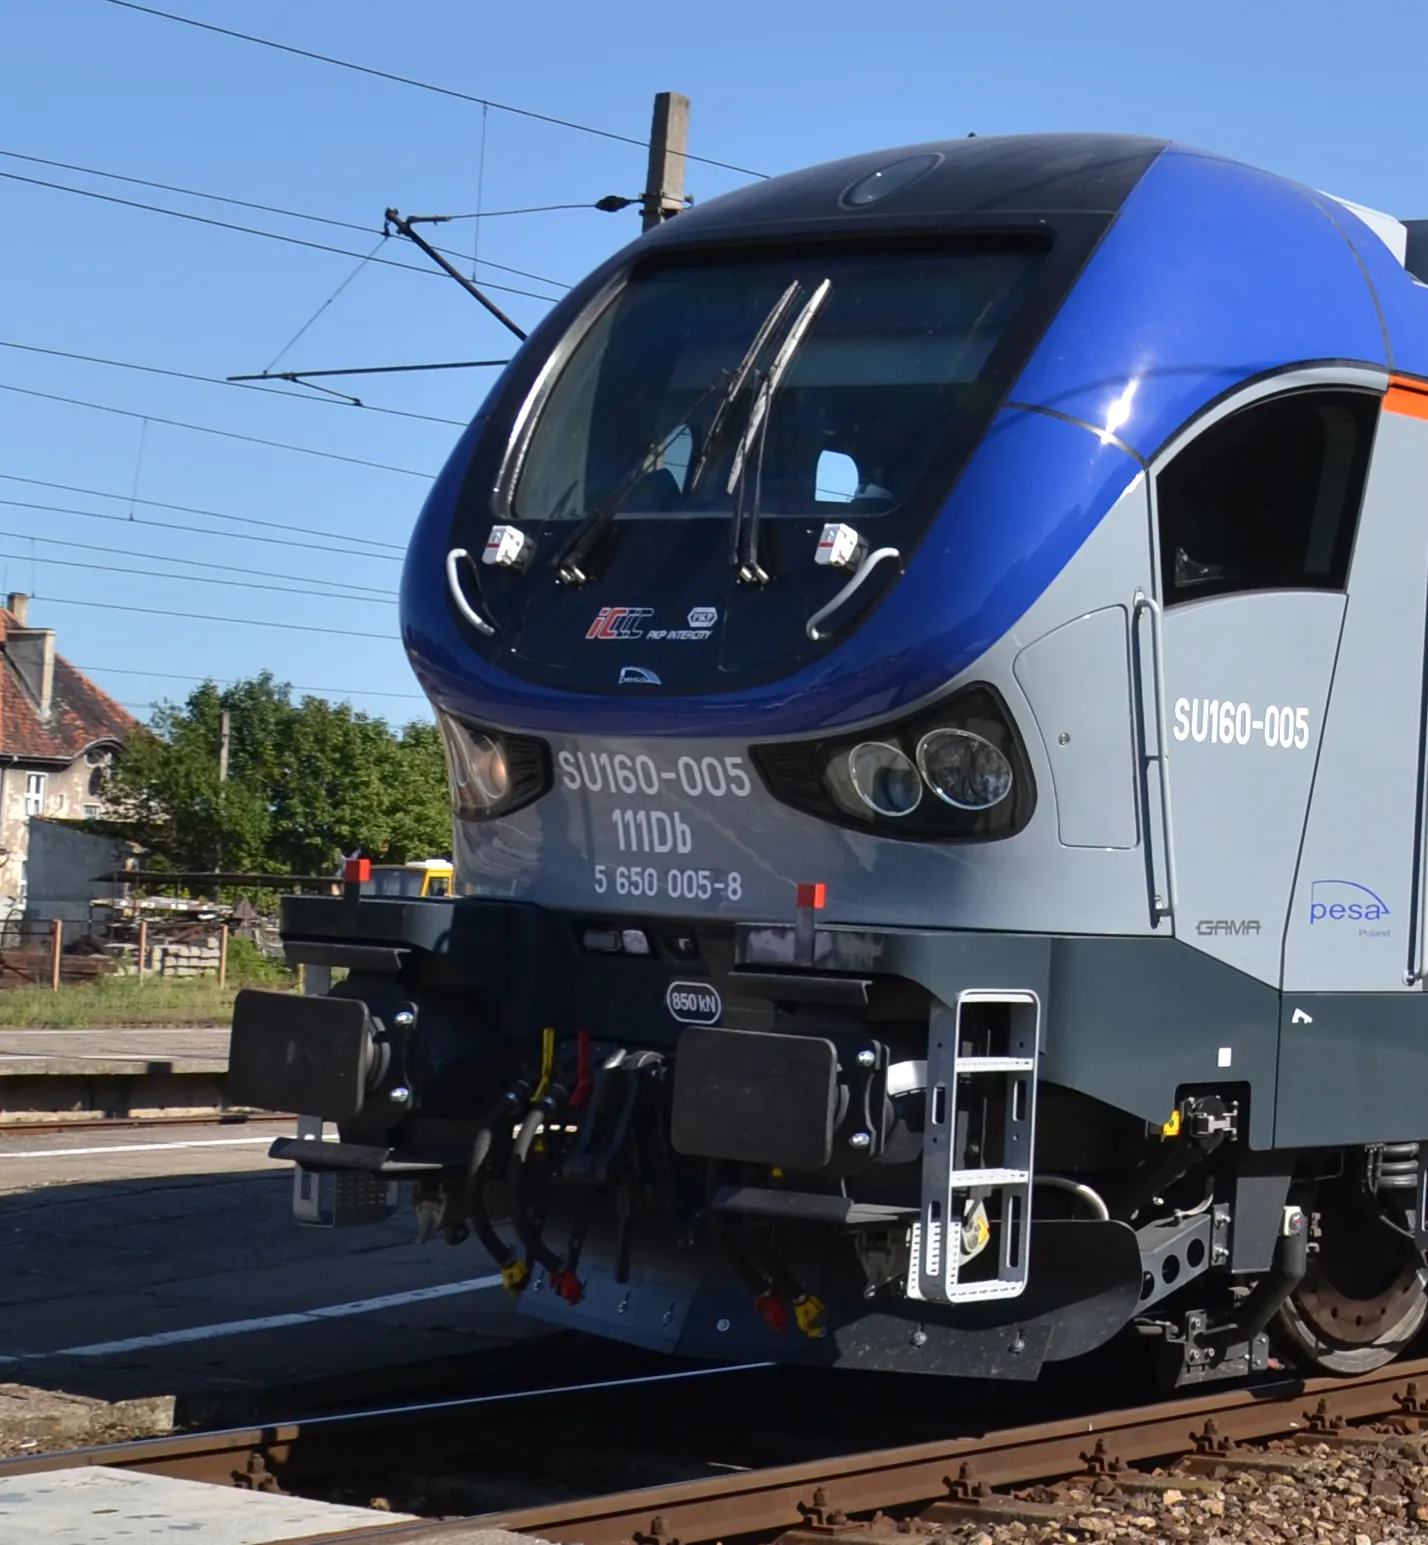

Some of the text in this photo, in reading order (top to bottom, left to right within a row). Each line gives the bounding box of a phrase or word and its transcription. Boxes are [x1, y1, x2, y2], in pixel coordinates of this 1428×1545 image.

[646, 630, 713, 640] PKP INTERCITY
[1173, 697, 1309, 750] SU160-005
[558, 751, 751, 797] SU160-005
[612, 809, 692, 854] 111Db
[594, 865, 742, 900] 5 650 005-8
[1195, 920, 1262, 936] GAMA
[1358, 928, 1391, 938] Poland
[672, 992, 716, 1013] 850 kN
